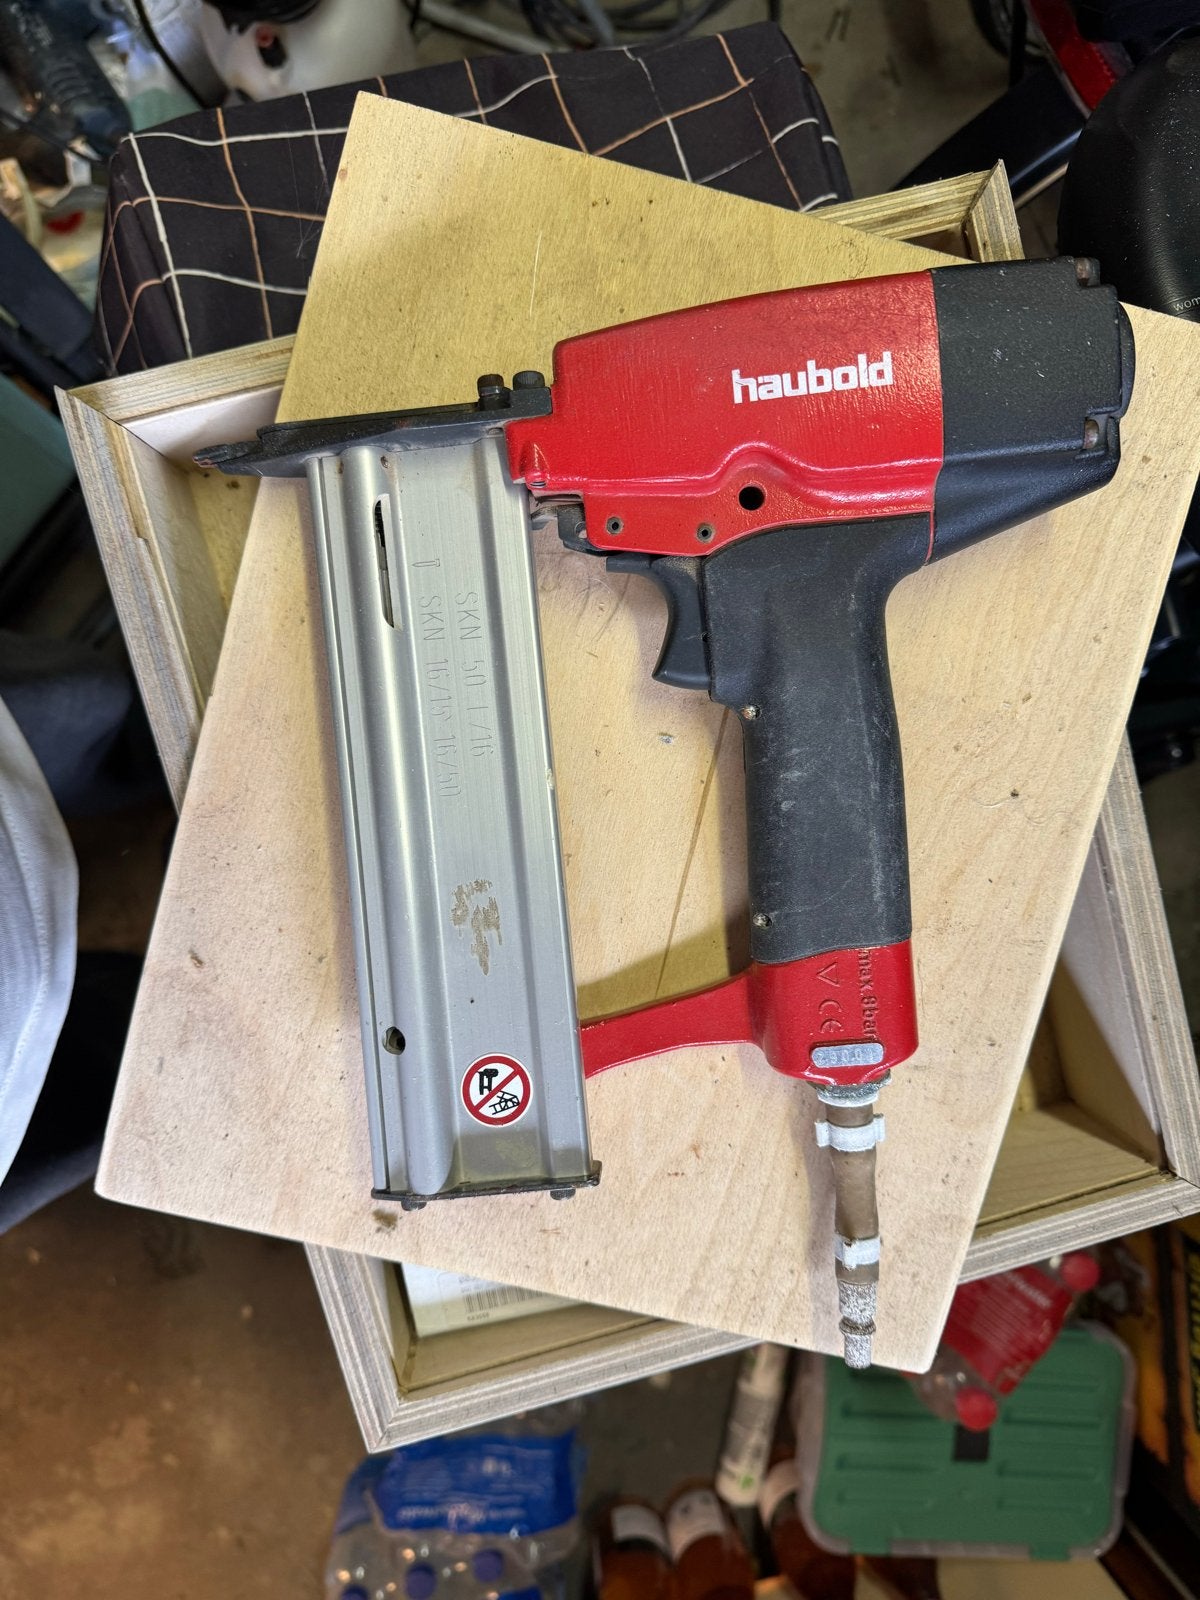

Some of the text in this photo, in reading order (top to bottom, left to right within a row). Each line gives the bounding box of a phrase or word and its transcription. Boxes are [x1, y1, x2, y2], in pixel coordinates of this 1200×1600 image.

[731, 351, 894, 404] haubold
[418, 595, 445, 641] SKN
[455, 591, 483, 640] SKN
